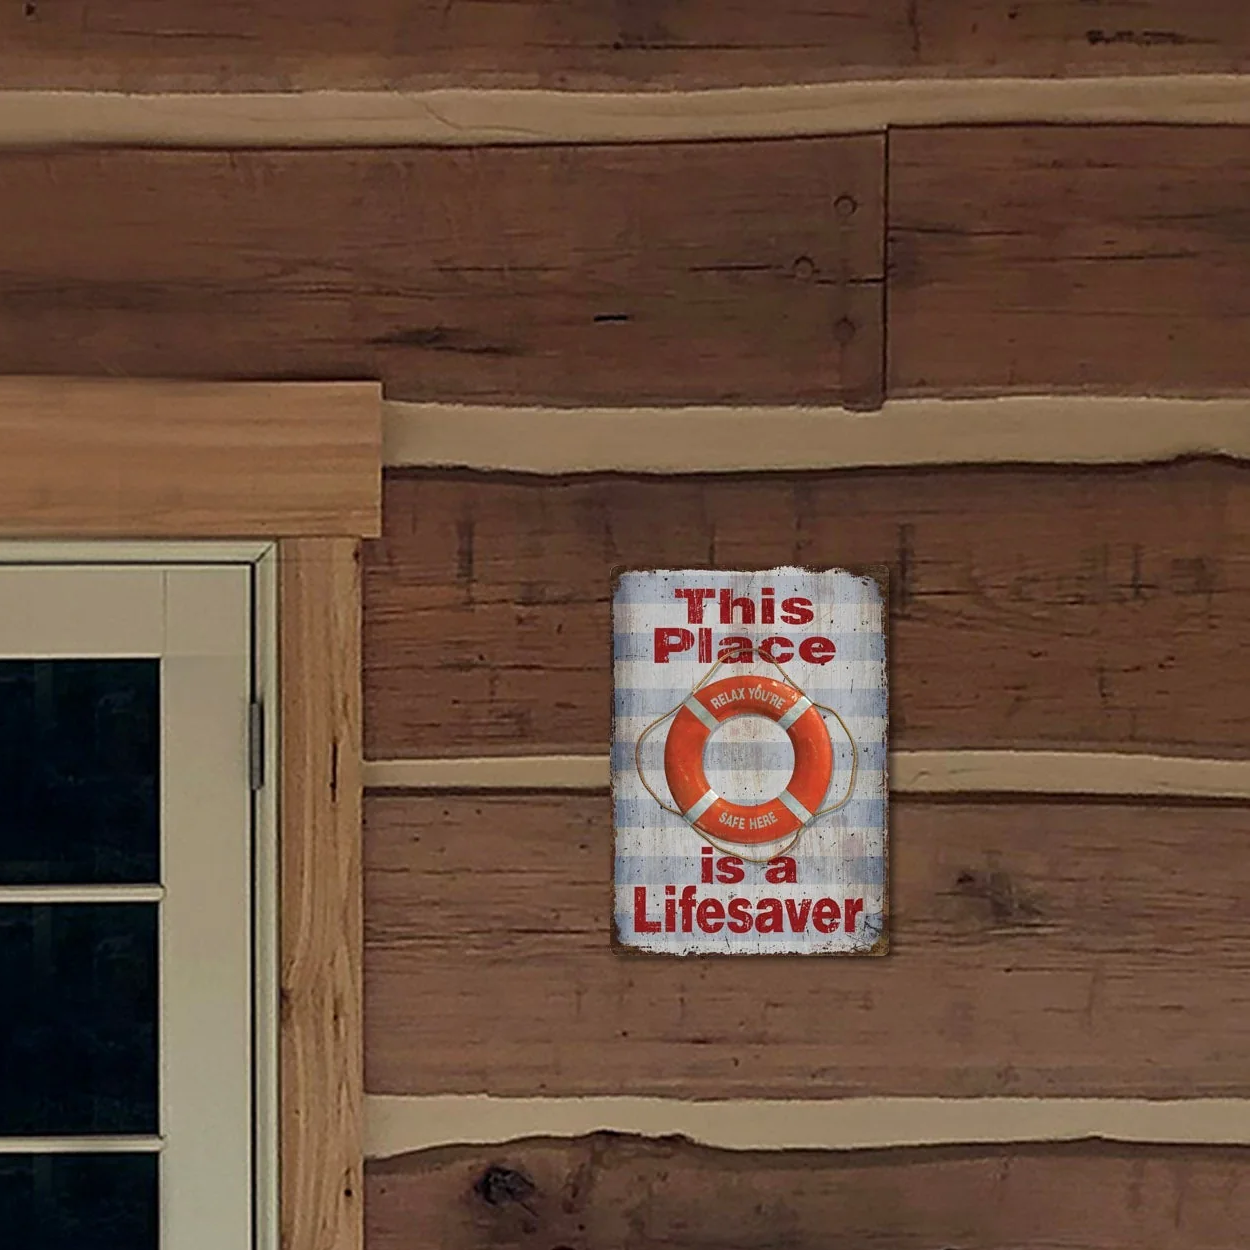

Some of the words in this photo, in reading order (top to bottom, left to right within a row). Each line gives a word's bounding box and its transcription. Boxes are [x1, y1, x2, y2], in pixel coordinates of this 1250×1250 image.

[675, 587, 814, 625] This
[653, 627, 836, 665] Place
[710, 687, 745, 710] RELAX
[718, 811, 746, 830] SAFE
[749, 811, 779, 830] HERE
[701, 846, 745, 884] is
[764, 855, 798, 884] a
[633, 885, 864, 934] Lifesaver
